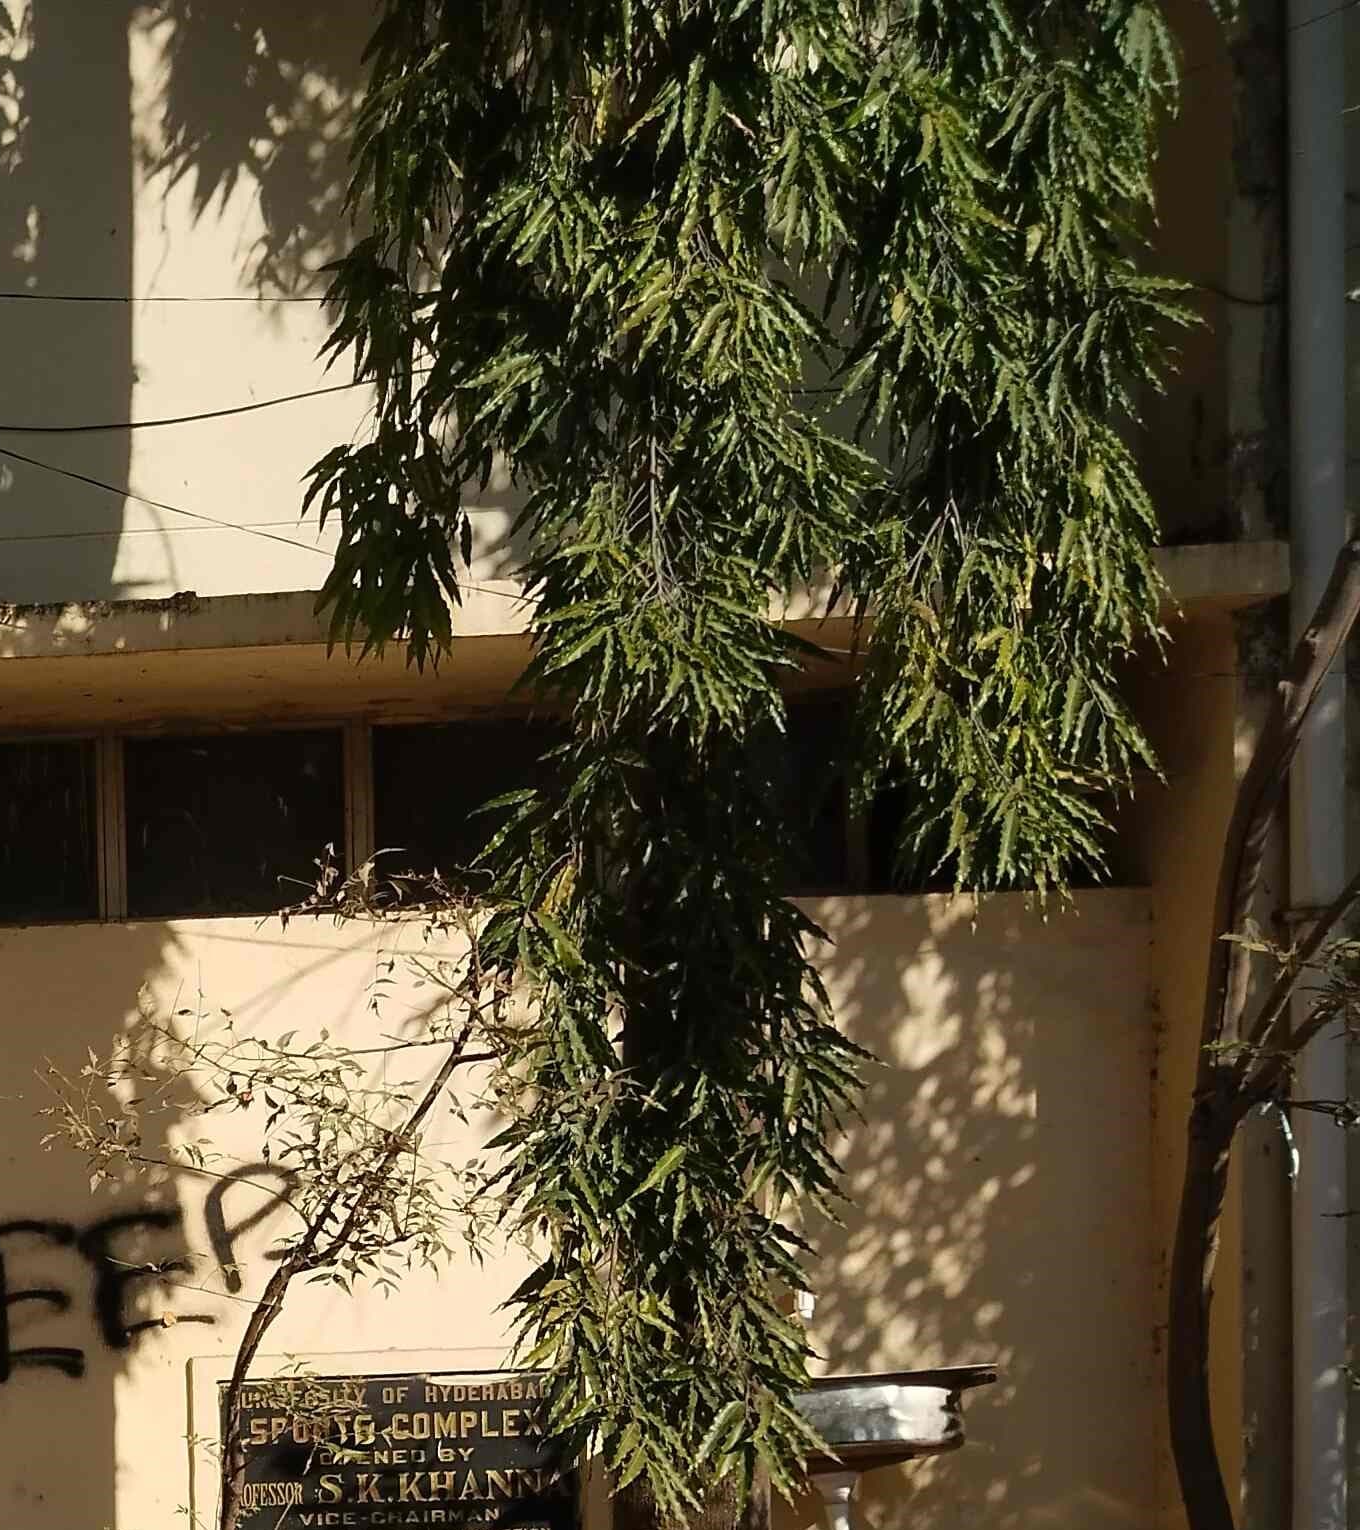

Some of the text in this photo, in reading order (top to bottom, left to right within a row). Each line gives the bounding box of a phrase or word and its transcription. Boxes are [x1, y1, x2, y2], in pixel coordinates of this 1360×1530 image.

[382, 1386, 409, 1404] OF
[391, 1408, 544, 1441] COMPLEX
[319, 1447, 475, 1465] ONED BY
[240, 1481, 304, 1508] OFESSOR
[299, 1507, 500, 1526] VICE-CHAIRMAN
